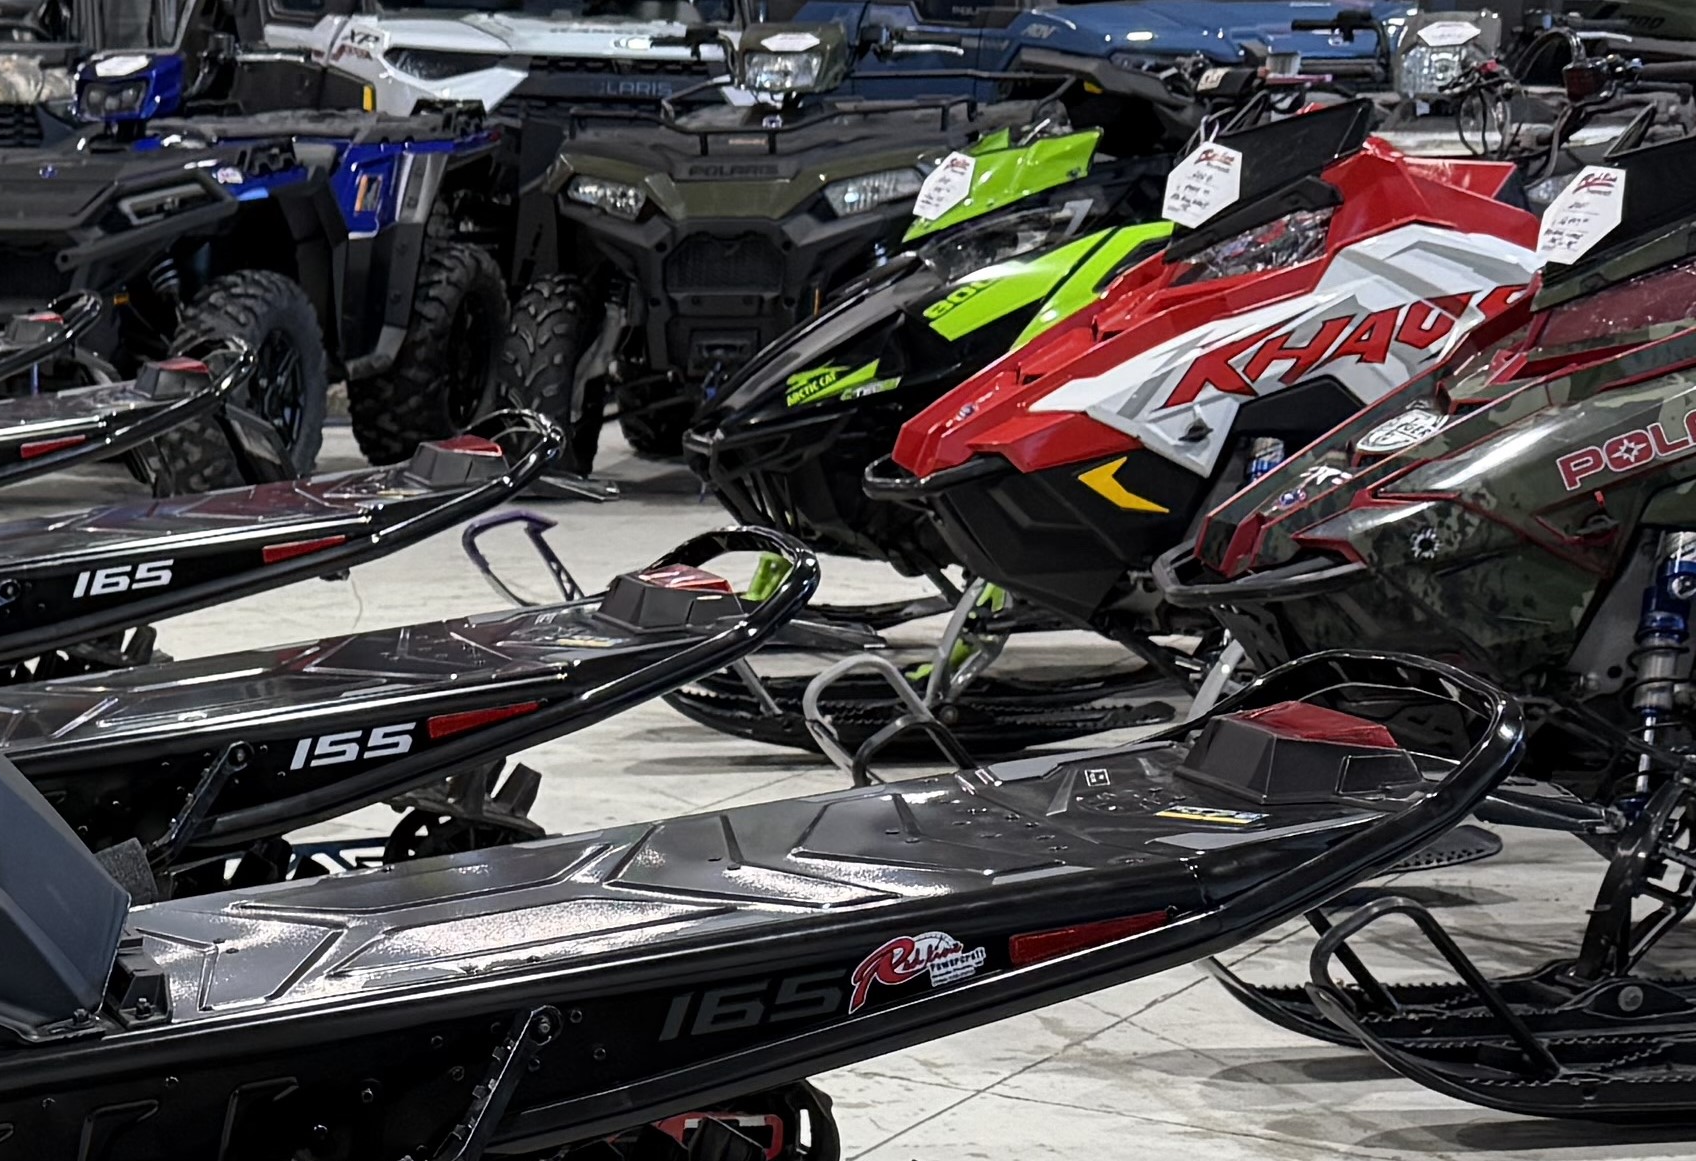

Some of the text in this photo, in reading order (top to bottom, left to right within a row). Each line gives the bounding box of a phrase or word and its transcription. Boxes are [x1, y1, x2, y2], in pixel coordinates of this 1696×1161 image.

[688, 164, 780, 179] POLARIS
[787, 370, 838, 407] ARCTIC CAT
[72, 559, 174, 599] 165
[289, 721, 417, 771] 155
[659, 968, 847, 1042] 165
